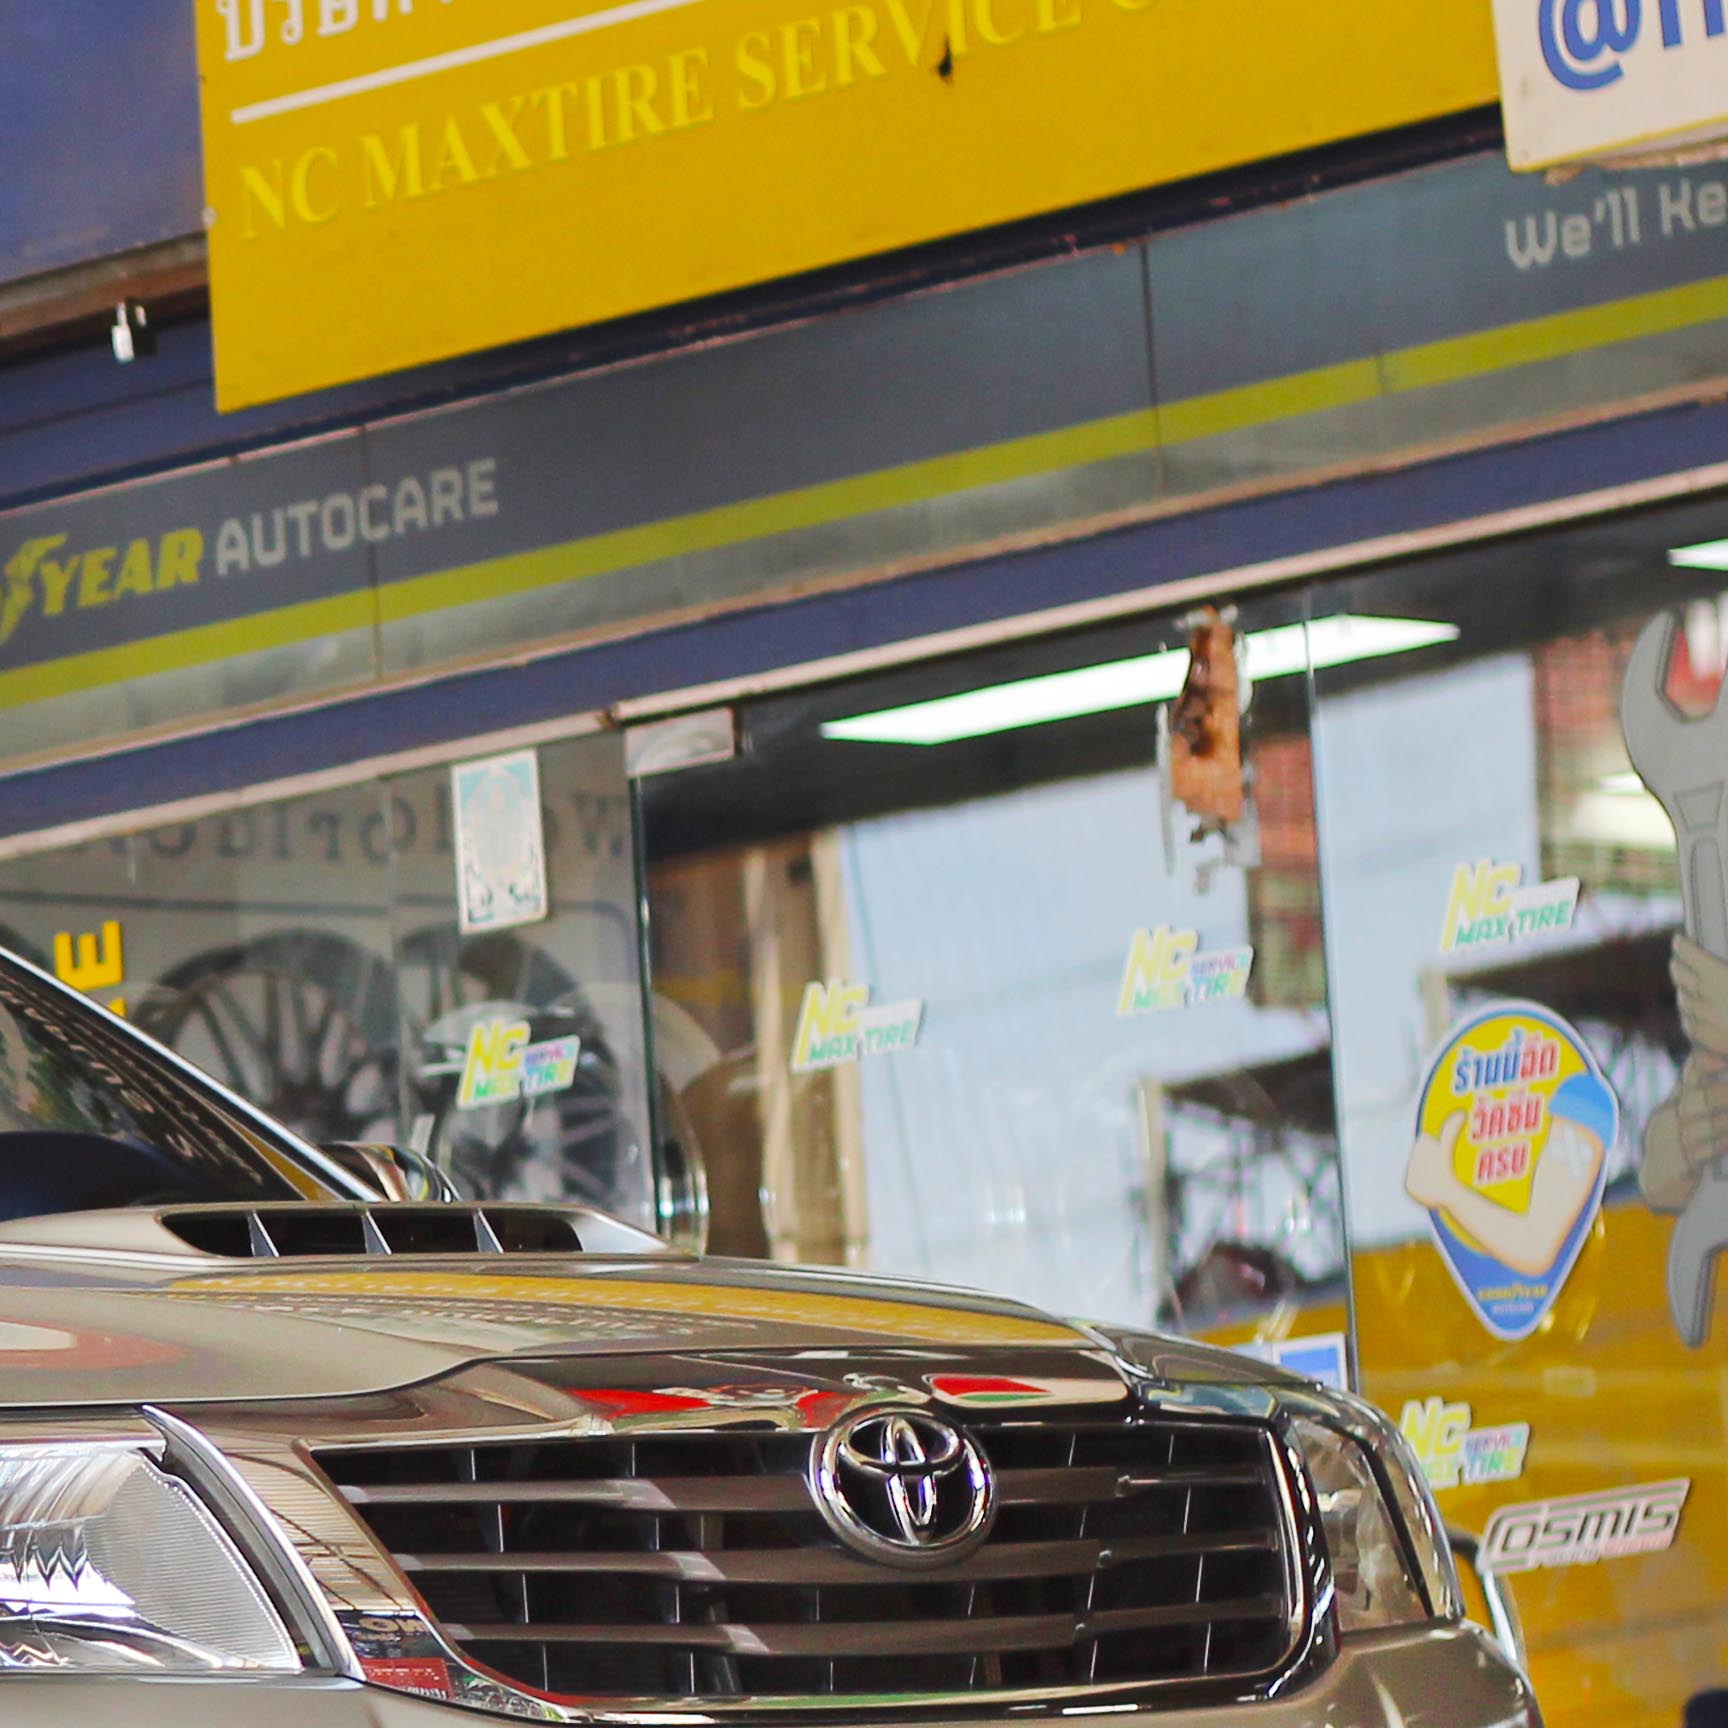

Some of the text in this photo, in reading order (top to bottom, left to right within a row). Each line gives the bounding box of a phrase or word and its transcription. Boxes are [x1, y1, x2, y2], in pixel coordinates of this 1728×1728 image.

[240, 147, 337, 240] NC
[360, 48, 715, 207] MAXTIRE
[1506, 184, 1640, 270] We'll
[217, 458, 500, 576] AUTOCARE
[1441, 861, 1517, 952] NC
[1120, 927, 1197, 1014] NC
[462, 1021, 527, 1103] NC
[796, 984, 866, 1064] NC
[1472, 1092, 1542, 1142] วัคซีน
[1477, 1142, 1529, 1184] ครบ
[1486, 1485, 1686, 1568] COSMIS
